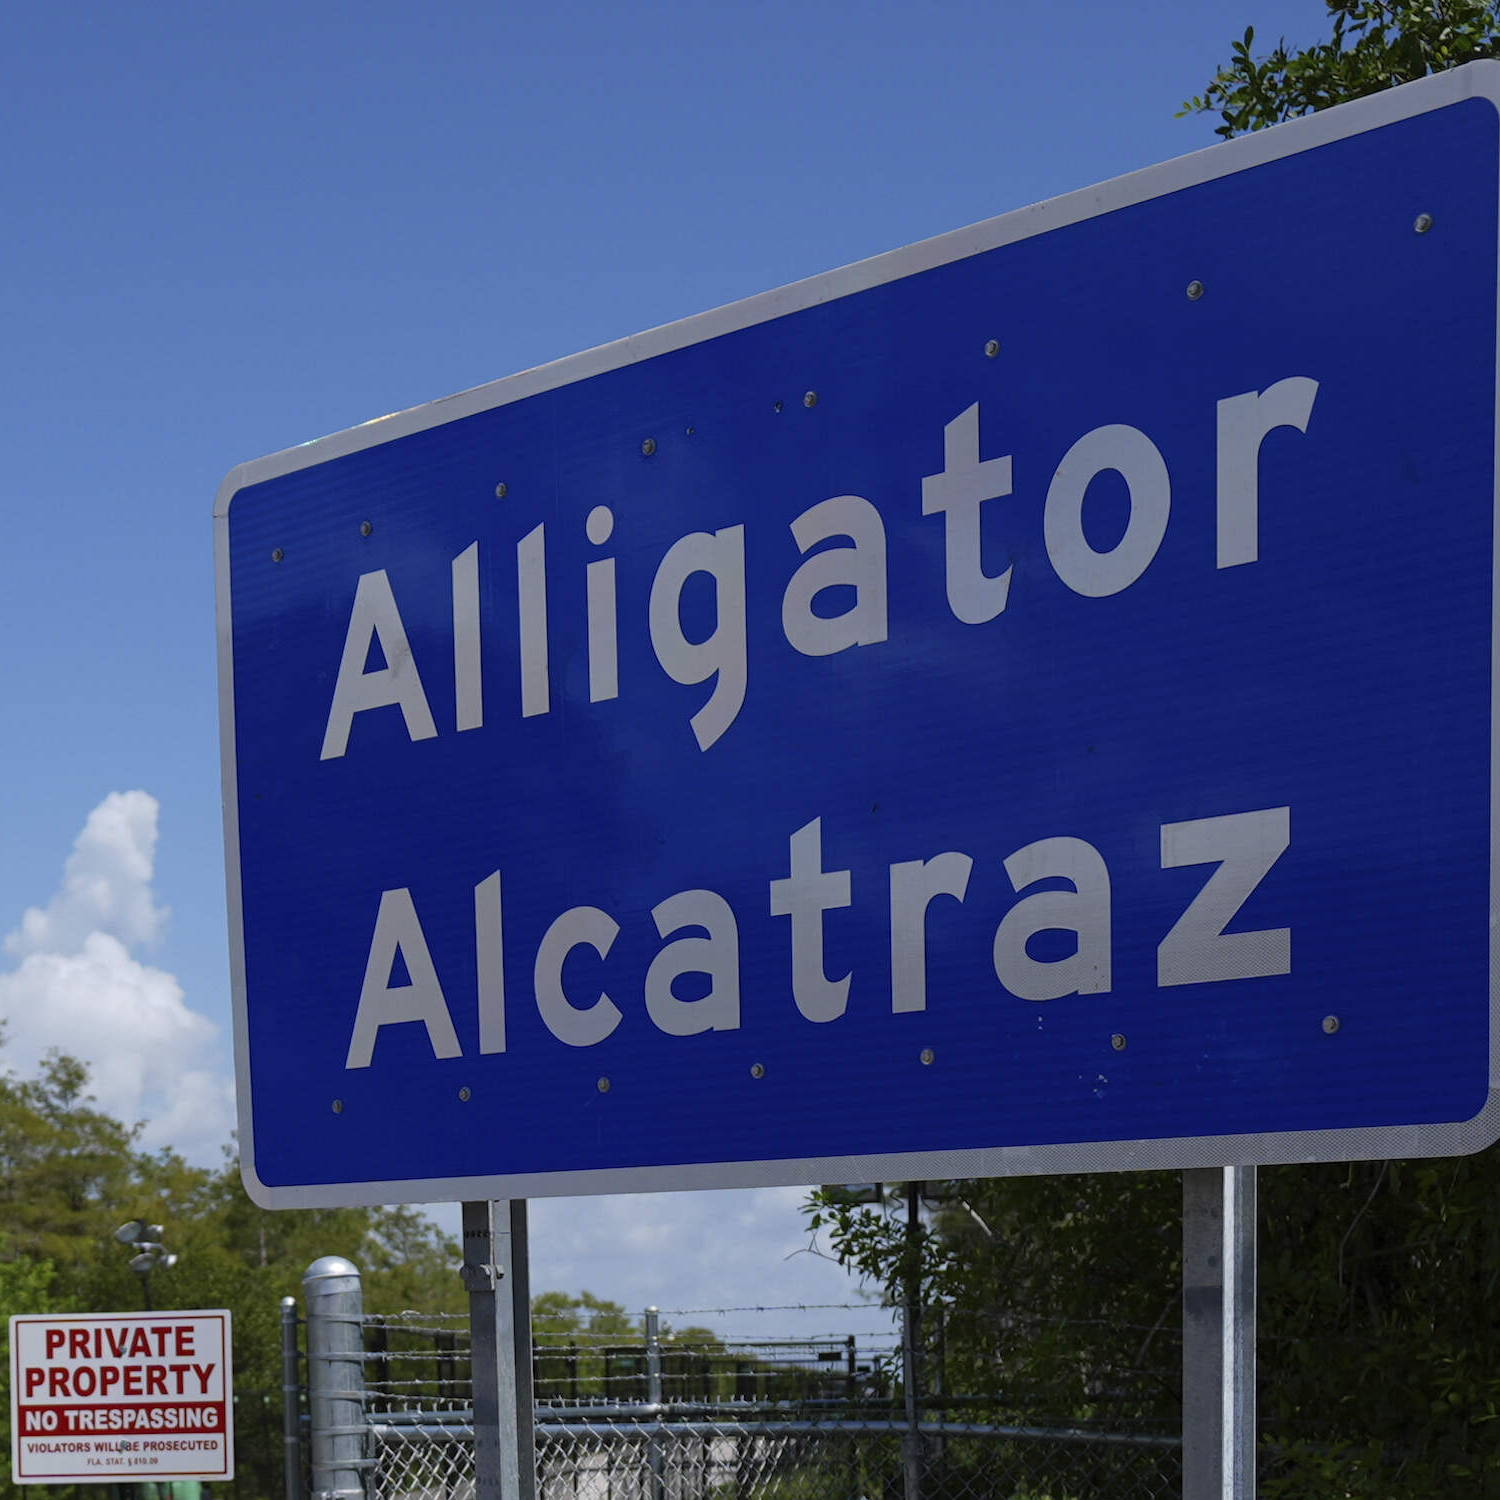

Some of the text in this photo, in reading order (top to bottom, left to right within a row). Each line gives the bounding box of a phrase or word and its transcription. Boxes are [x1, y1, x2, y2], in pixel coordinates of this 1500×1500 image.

[320, 376, 1320, 760] Alligator
[345, 806, 1292, 1069] Alcatraz
[46, 1326, 195, 1359] PRIVATE
[25, 1364, 215, 1397] PROPERTY
[26, 1407, 218, 1431] NO TRESPASSING
[28, 1440, 218, 1453] VIOLATORS WILL BE PROSECUTED
